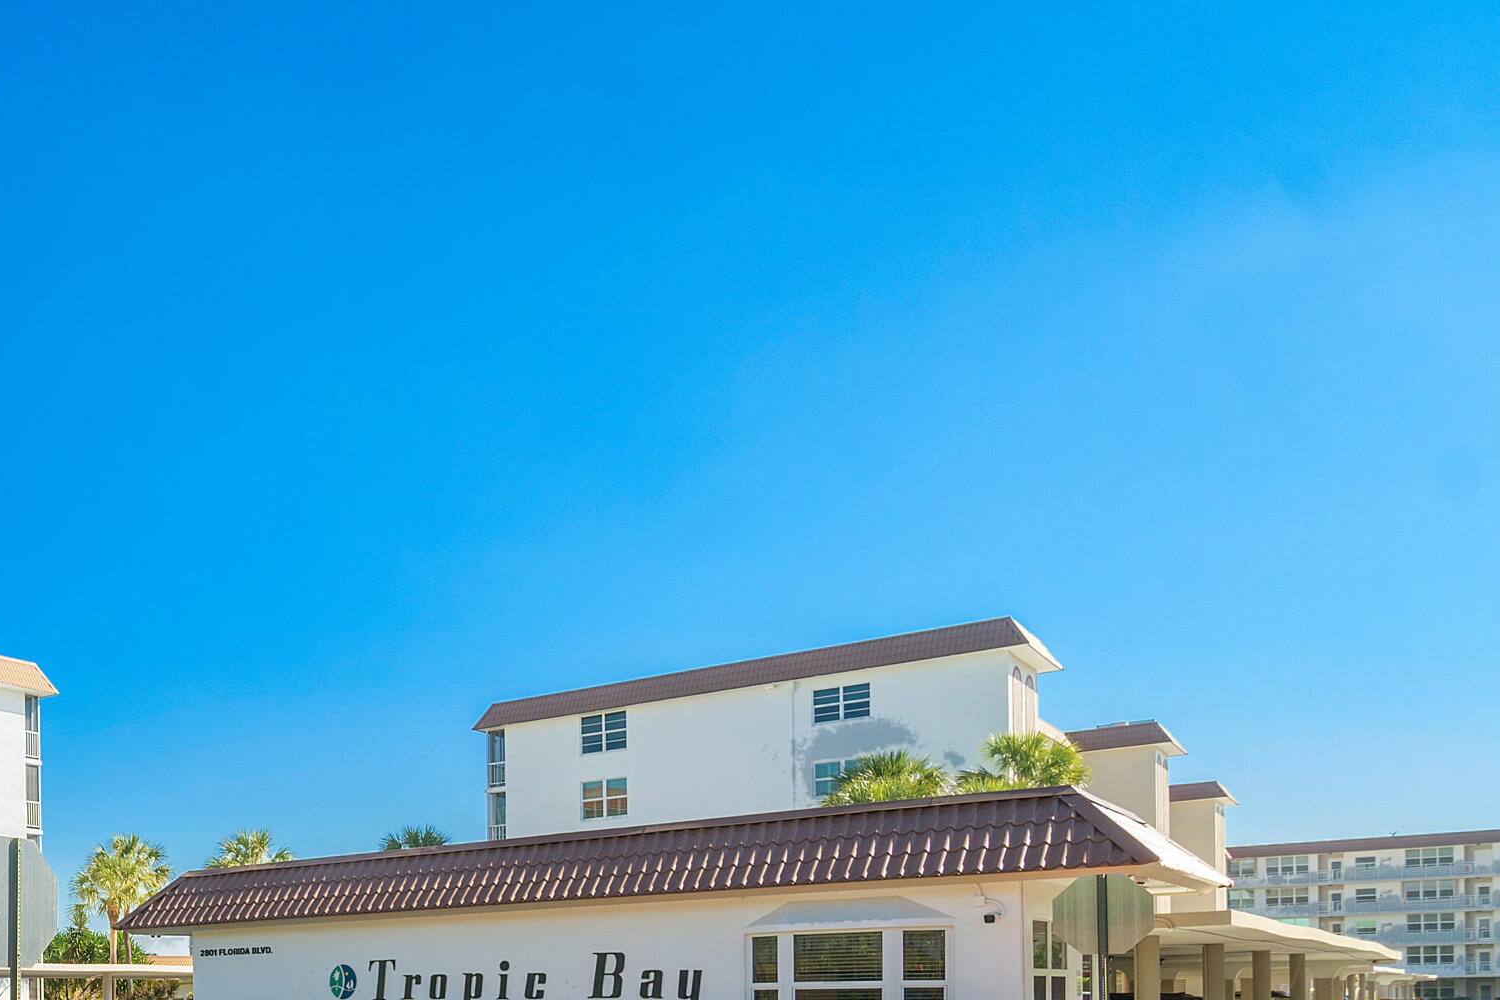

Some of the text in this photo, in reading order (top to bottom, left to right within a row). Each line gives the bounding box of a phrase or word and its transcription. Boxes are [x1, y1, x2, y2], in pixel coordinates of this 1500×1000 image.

[200, 946, 273, 957] 2801 FLORIDA BLVD.
